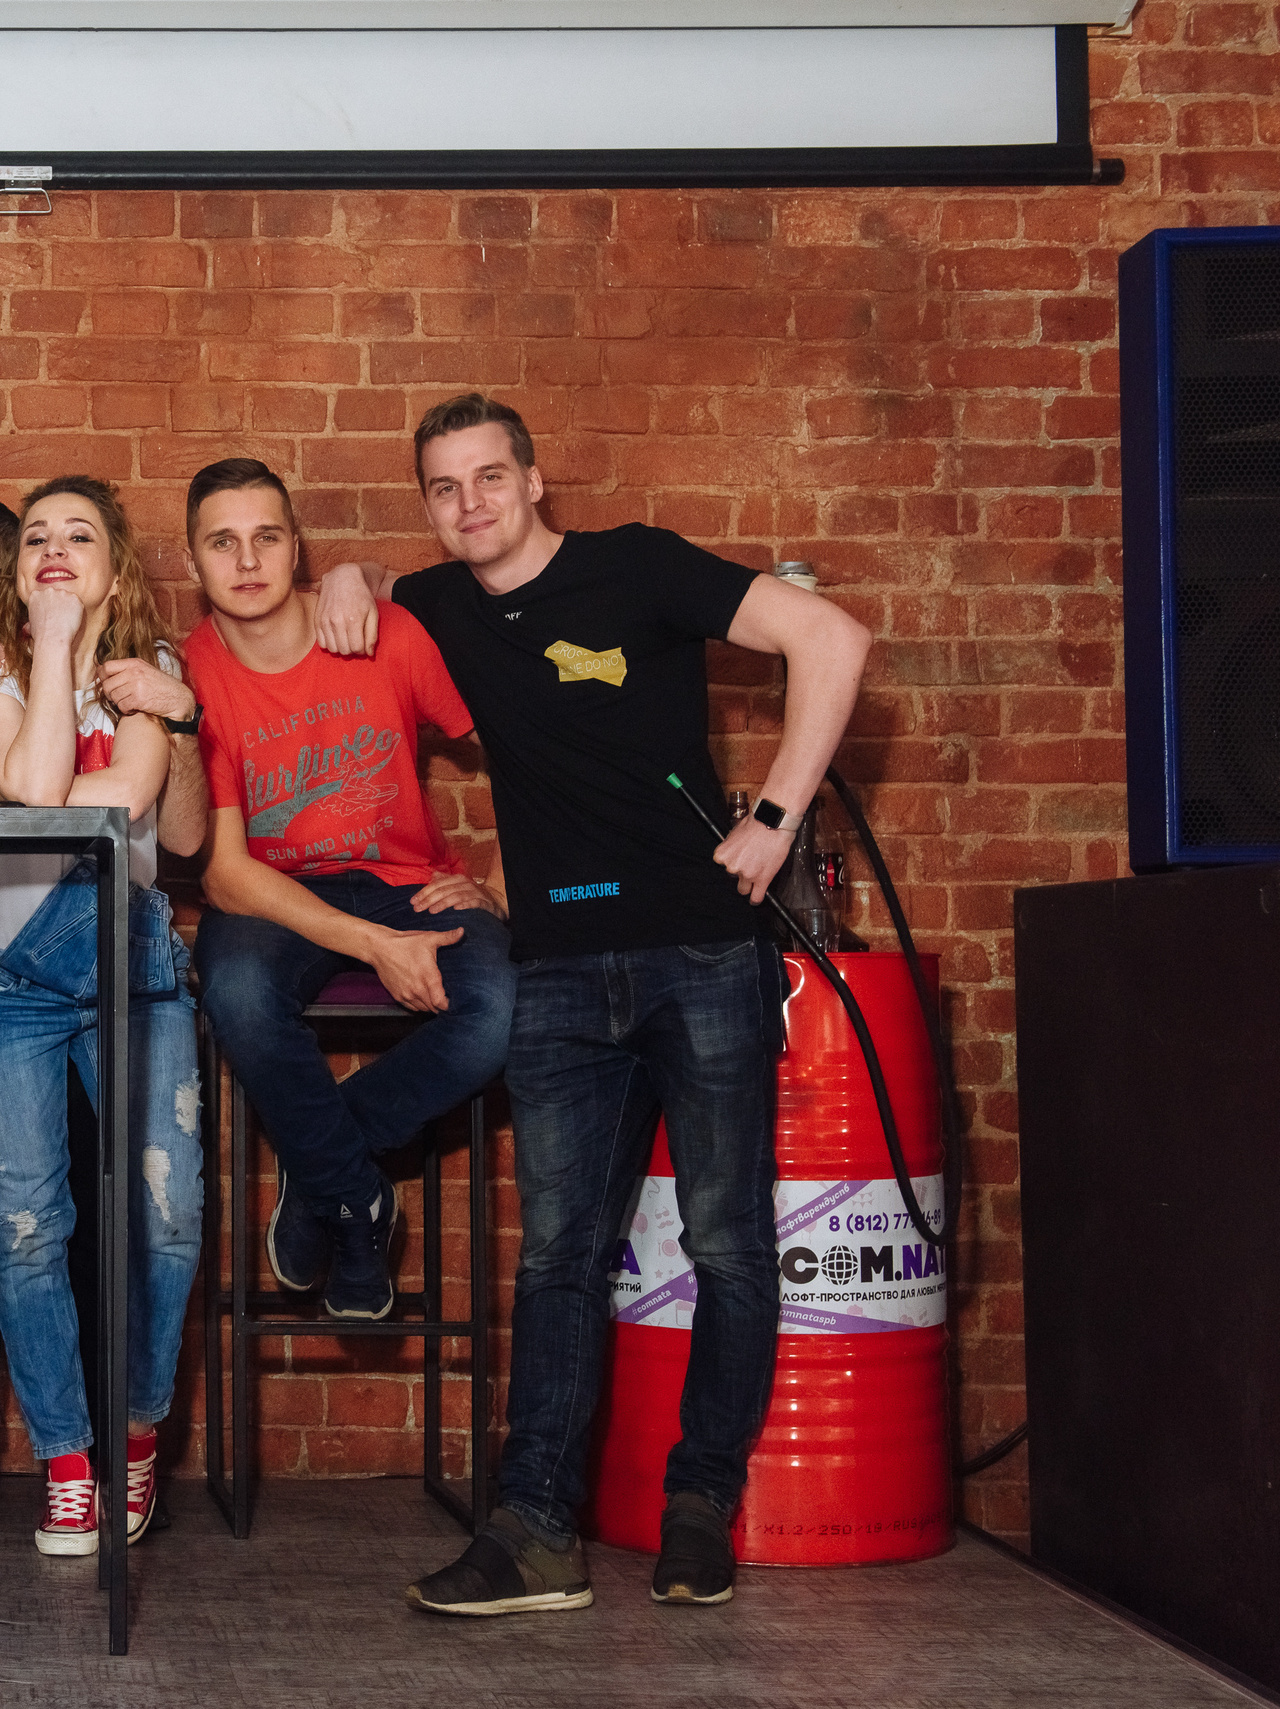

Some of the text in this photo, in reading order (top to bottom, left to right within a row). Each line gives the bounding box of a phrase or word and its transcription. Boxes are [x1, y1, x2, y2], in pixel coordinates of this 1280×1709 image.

[585, 659, 601, 672] DO
[243, 696, 365, 749] CALIFORNIA
[266, 847, 297, 861] SUN
[305, 838, 335, 857] AND
[341, 816, 394, 846] WAVES
[829, 1215, 841, 1232] 8
[846, 1211, 889, 1234] (812)
[632, 1289, 672, 1316] #comnata
[782, 1289, 899, 1302] ЛОФТ-ПРОСТРАНСТВО
[900, 1288, 916, 1300] ДЛЯ
